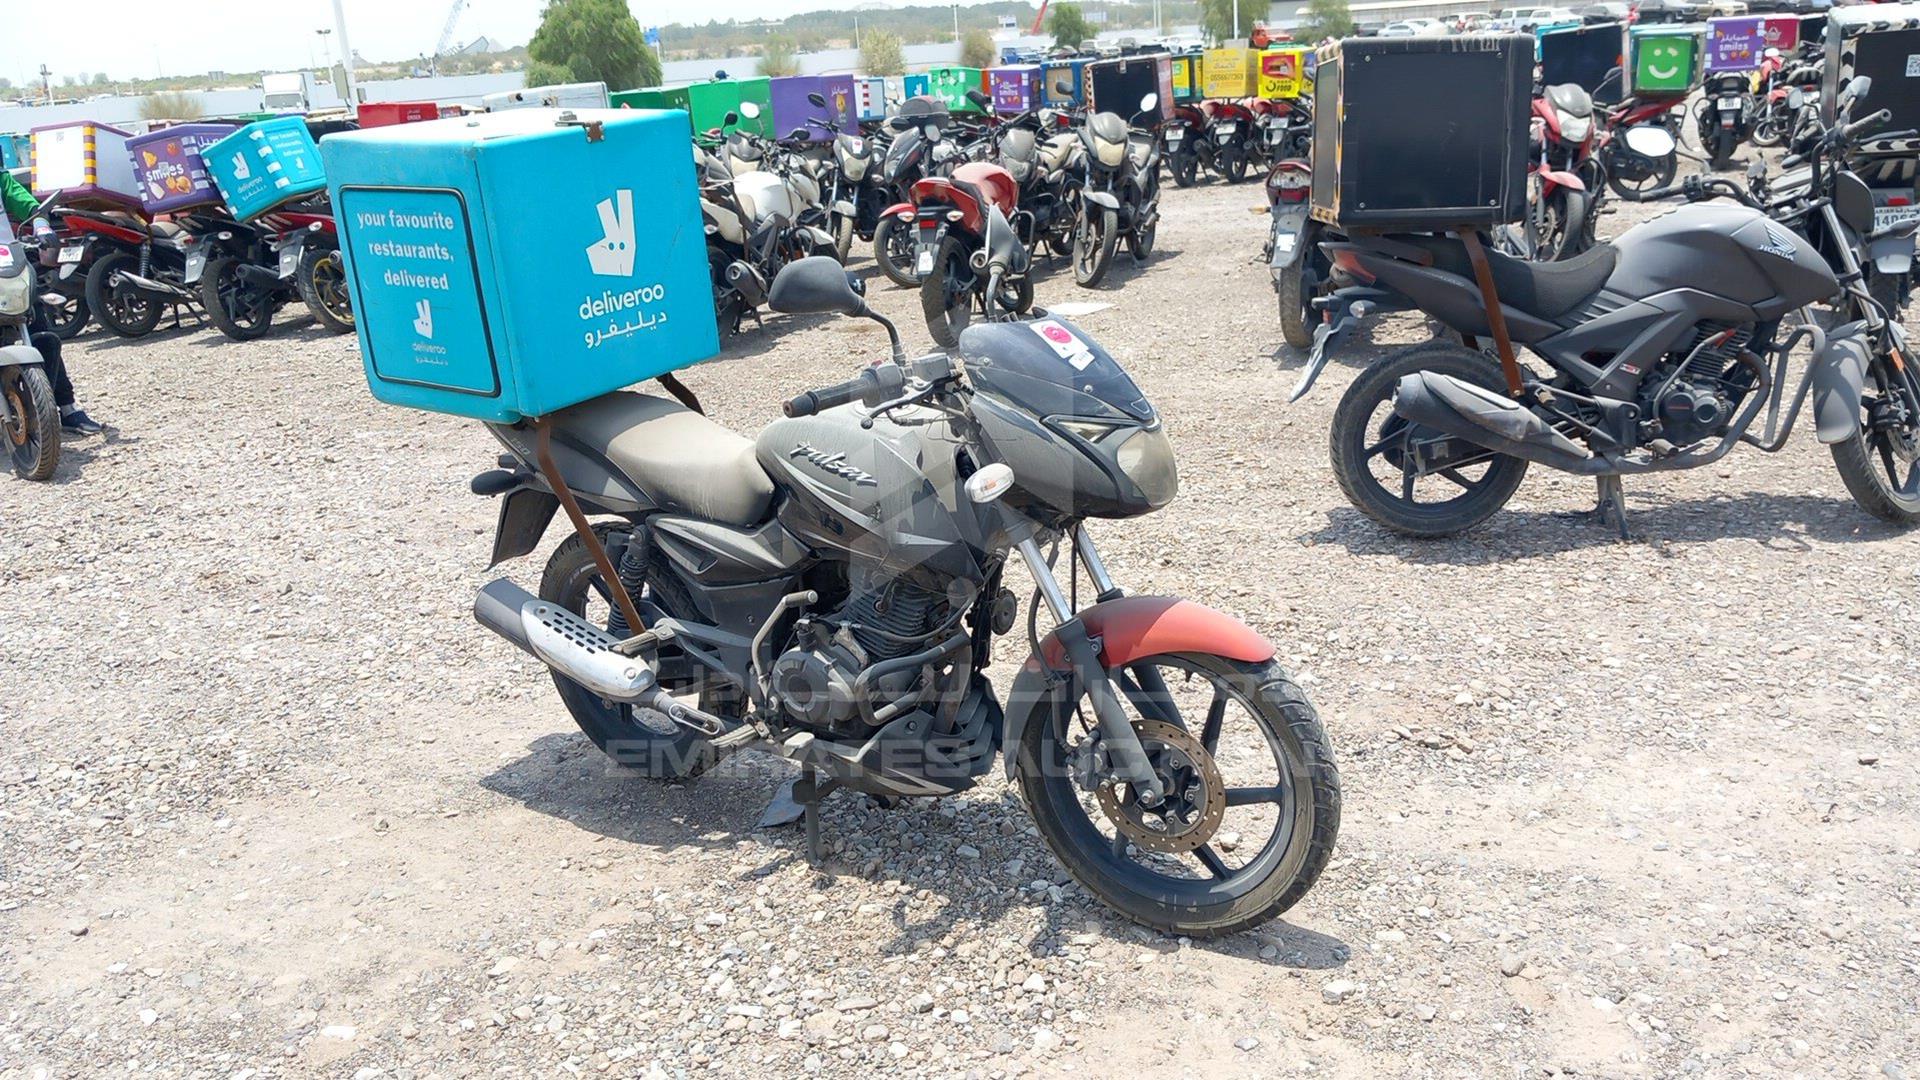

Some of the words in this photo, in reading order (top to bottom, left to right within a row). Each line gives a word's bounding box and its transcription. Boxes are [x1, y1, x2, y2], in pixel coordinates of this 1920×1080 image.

[357, 212, 386, 229] your
[389, 209, 454, 230] favourite
[368, 240, 454, 262] restaurants,
[1757, 244, 1794, 261] HONDA
[384, 269, 449, 290] delivered
[579, 283, 665, 320] deliveroo
[584, 310, 668, 349] ديليفرو
[412, 342, 447, 355] deliveroo
